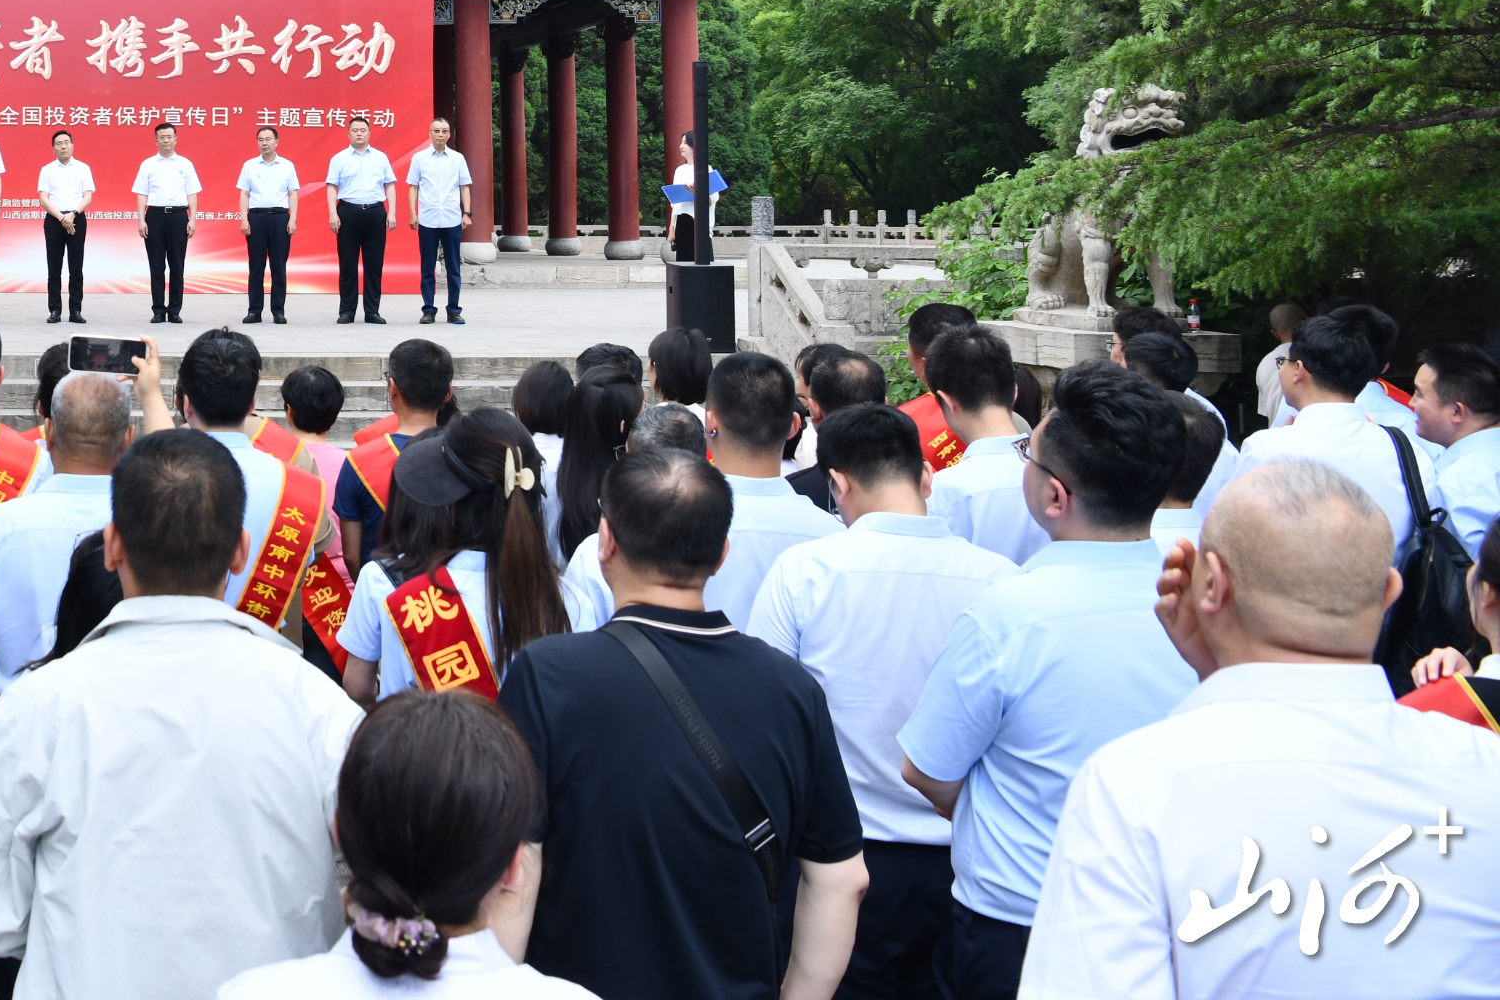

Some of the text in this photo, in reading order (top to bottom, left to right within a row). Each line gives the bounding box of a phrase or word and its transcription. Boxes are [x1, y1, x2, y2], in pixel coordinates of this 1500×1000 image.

[85, 14, 396, 82] 携手共行动
[246, 506, 306, 619] 太原南中环街
[400, 585, 480, 694] 桃园
